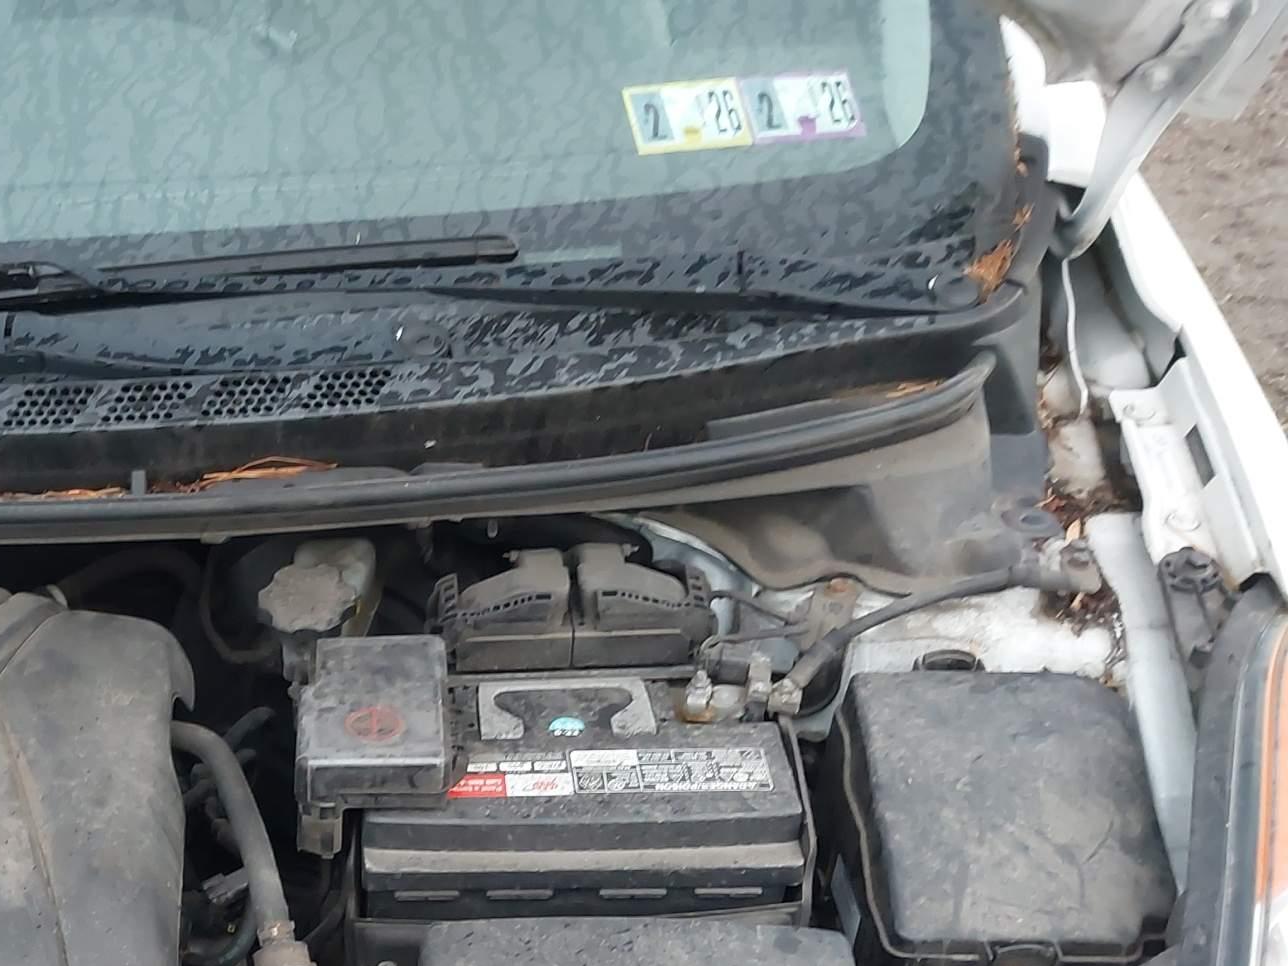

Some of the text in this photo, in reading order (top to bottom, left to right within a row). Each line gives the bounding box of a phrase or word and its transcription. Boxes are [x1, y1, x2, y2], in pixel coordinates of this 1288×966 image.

[643, 89, 743, 141] 2 26
[758, 80, 856, 130] 2 26
